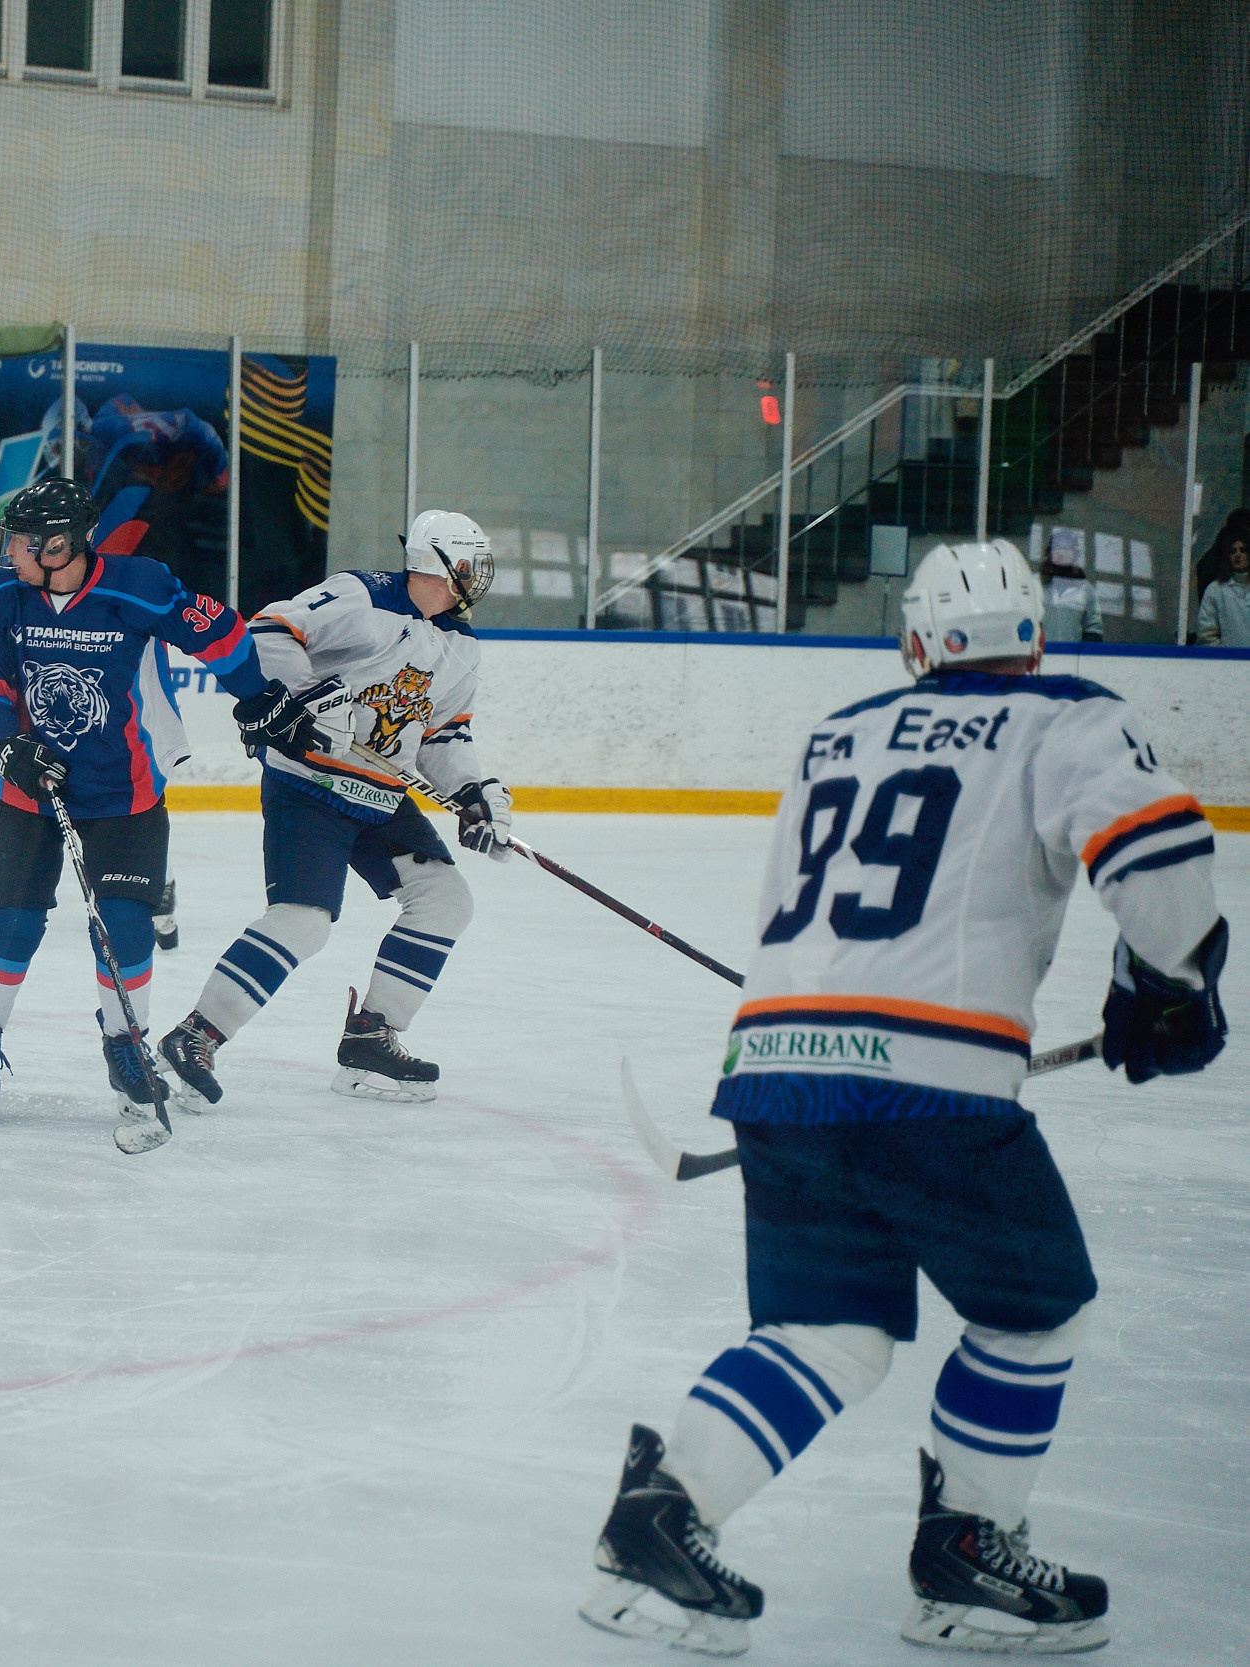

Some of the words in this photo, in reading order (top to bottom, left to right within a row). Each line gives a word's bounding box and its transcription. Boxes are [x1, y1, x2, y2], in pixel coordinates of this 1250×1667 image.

[182, 593, 225, 633] 32
[26, 626, 125, 642] ТРАНСНЕФТЬ
[26, 638, 72, 650] ДАЛЬНИЙ
[74, 643, 112, 652] ВОСТОК
[887, 706, 1010, 751] East
[761, 764, 963, 948] 99
[101, 873, 151, 885] BAUER
[745, 1031, 892, 1065] SBERBANK
